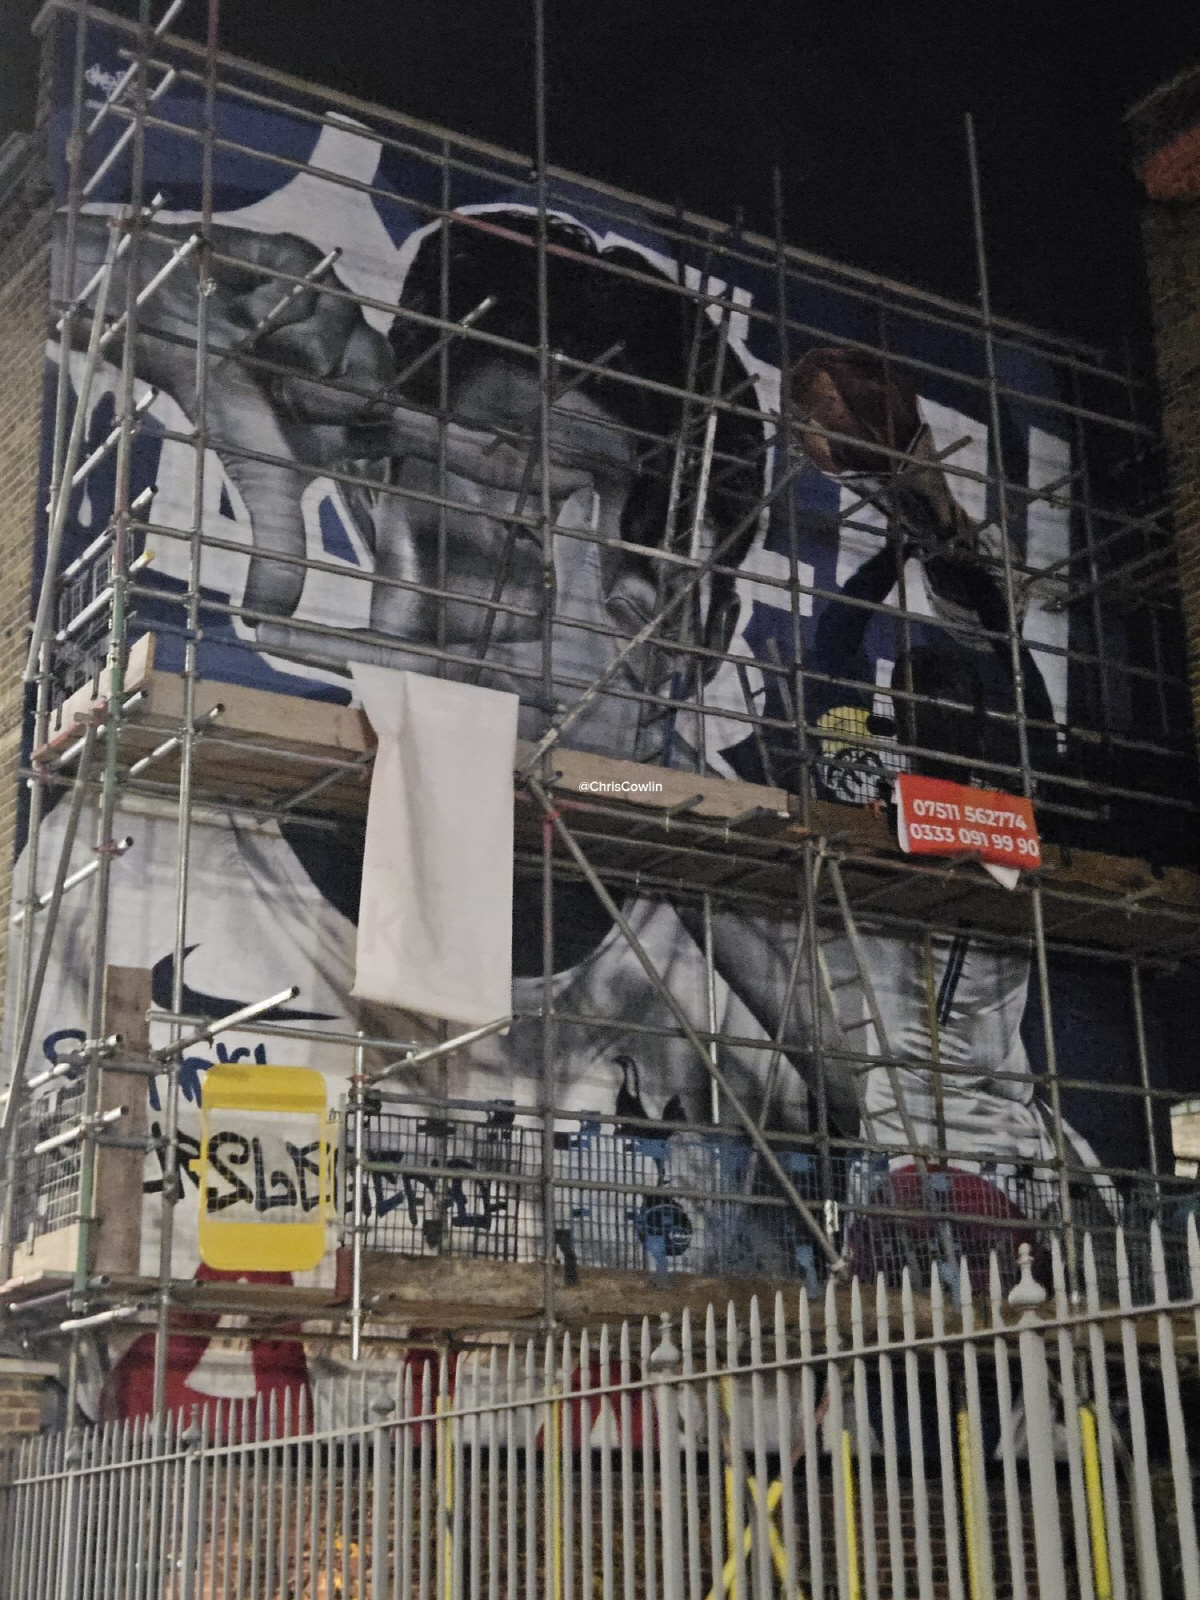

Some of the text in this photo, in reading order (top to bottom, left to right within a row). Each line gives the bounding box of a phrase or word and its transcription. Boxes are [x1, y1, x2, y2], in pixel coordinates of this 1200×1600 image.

[913, 799, 1027, 831] 07511 562774
[910, 823, 1040, 857] 0333 091 99 90
